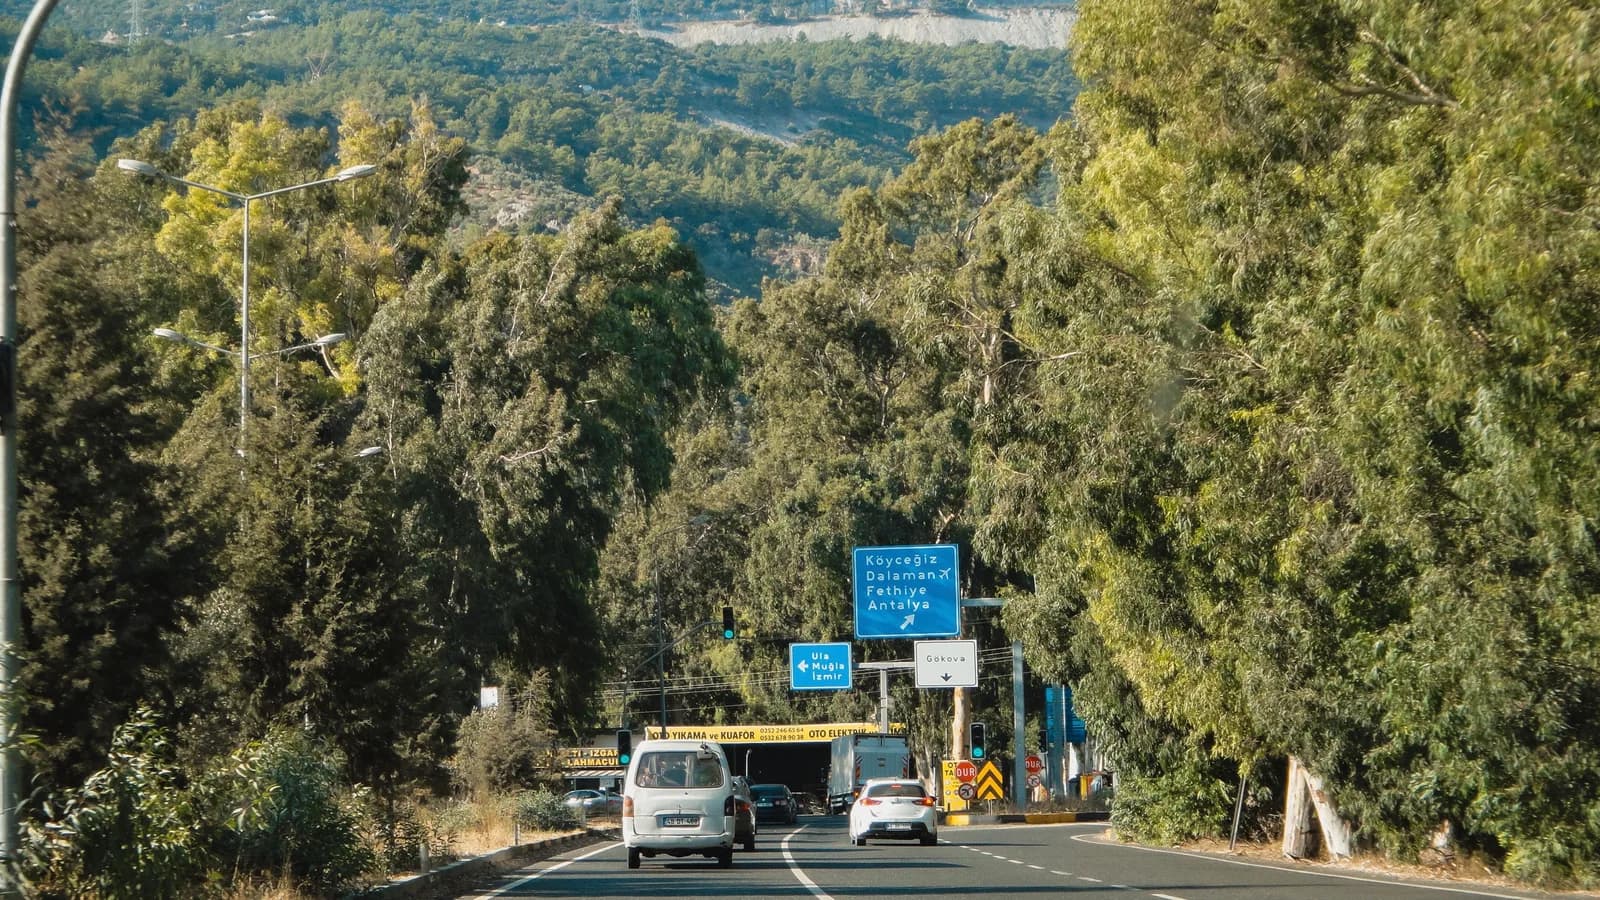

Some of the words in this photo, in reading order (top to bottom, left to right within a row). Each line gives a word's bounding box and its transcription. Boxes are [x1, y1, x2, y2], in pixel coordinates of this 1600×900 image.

[865, 554, 937, 568] Köyceğiz
[866, 570, 936, 582] Dalaman
[866, 585, 927, 598] Fethiye
[868, 599, 930, 612] Antalya
[811, 652, 830, 660] Ula
[926, 654, 966, 663] Gökova
[811, 661, 845, 672] Muğla
[672, 731, 707, 740] YIKAMA
[808, 729, 827, 738] OTO
[1025, 760, 1041, 769] DUR
[956, 767, 975, 777] DUR
